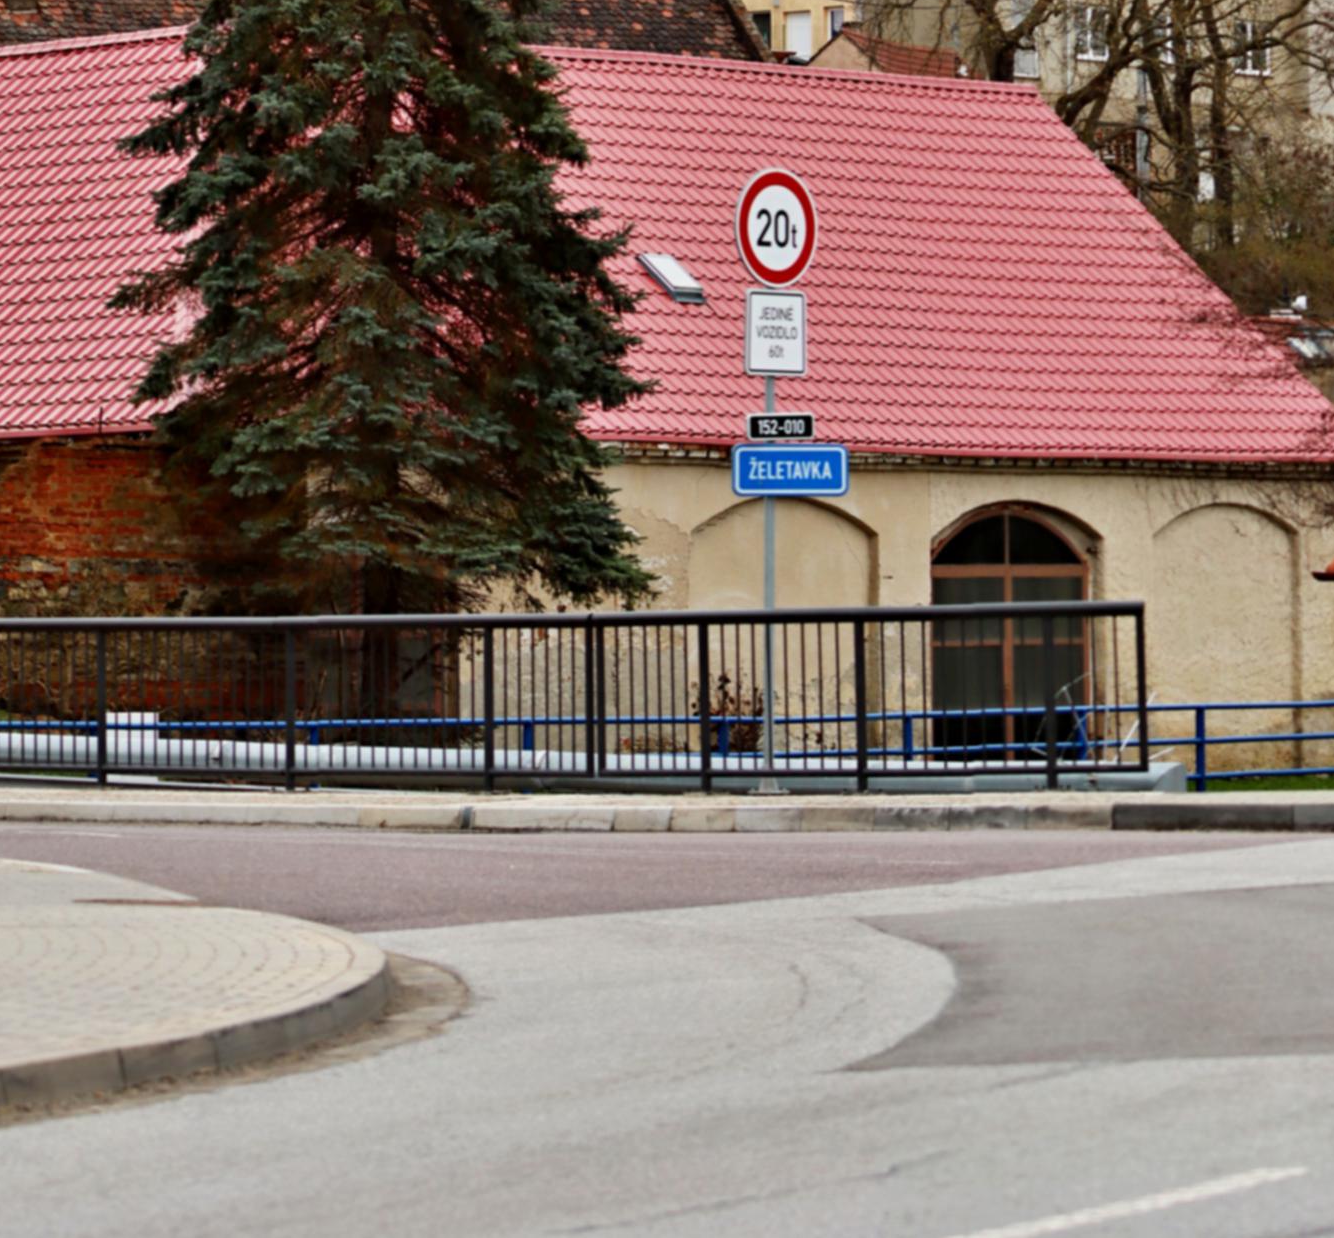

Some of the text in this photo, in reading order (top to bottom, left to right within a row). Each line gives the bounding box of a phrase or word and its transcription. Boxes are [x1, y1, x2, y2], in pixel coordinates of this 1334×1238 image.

[758, 306, 794, 321] JEDINÉ
[755, 325, 798, 340] VOZIDLO
[757, 418, 806, 435] 152-010
[748, 456, 833, 480] ŽELETAVKA
